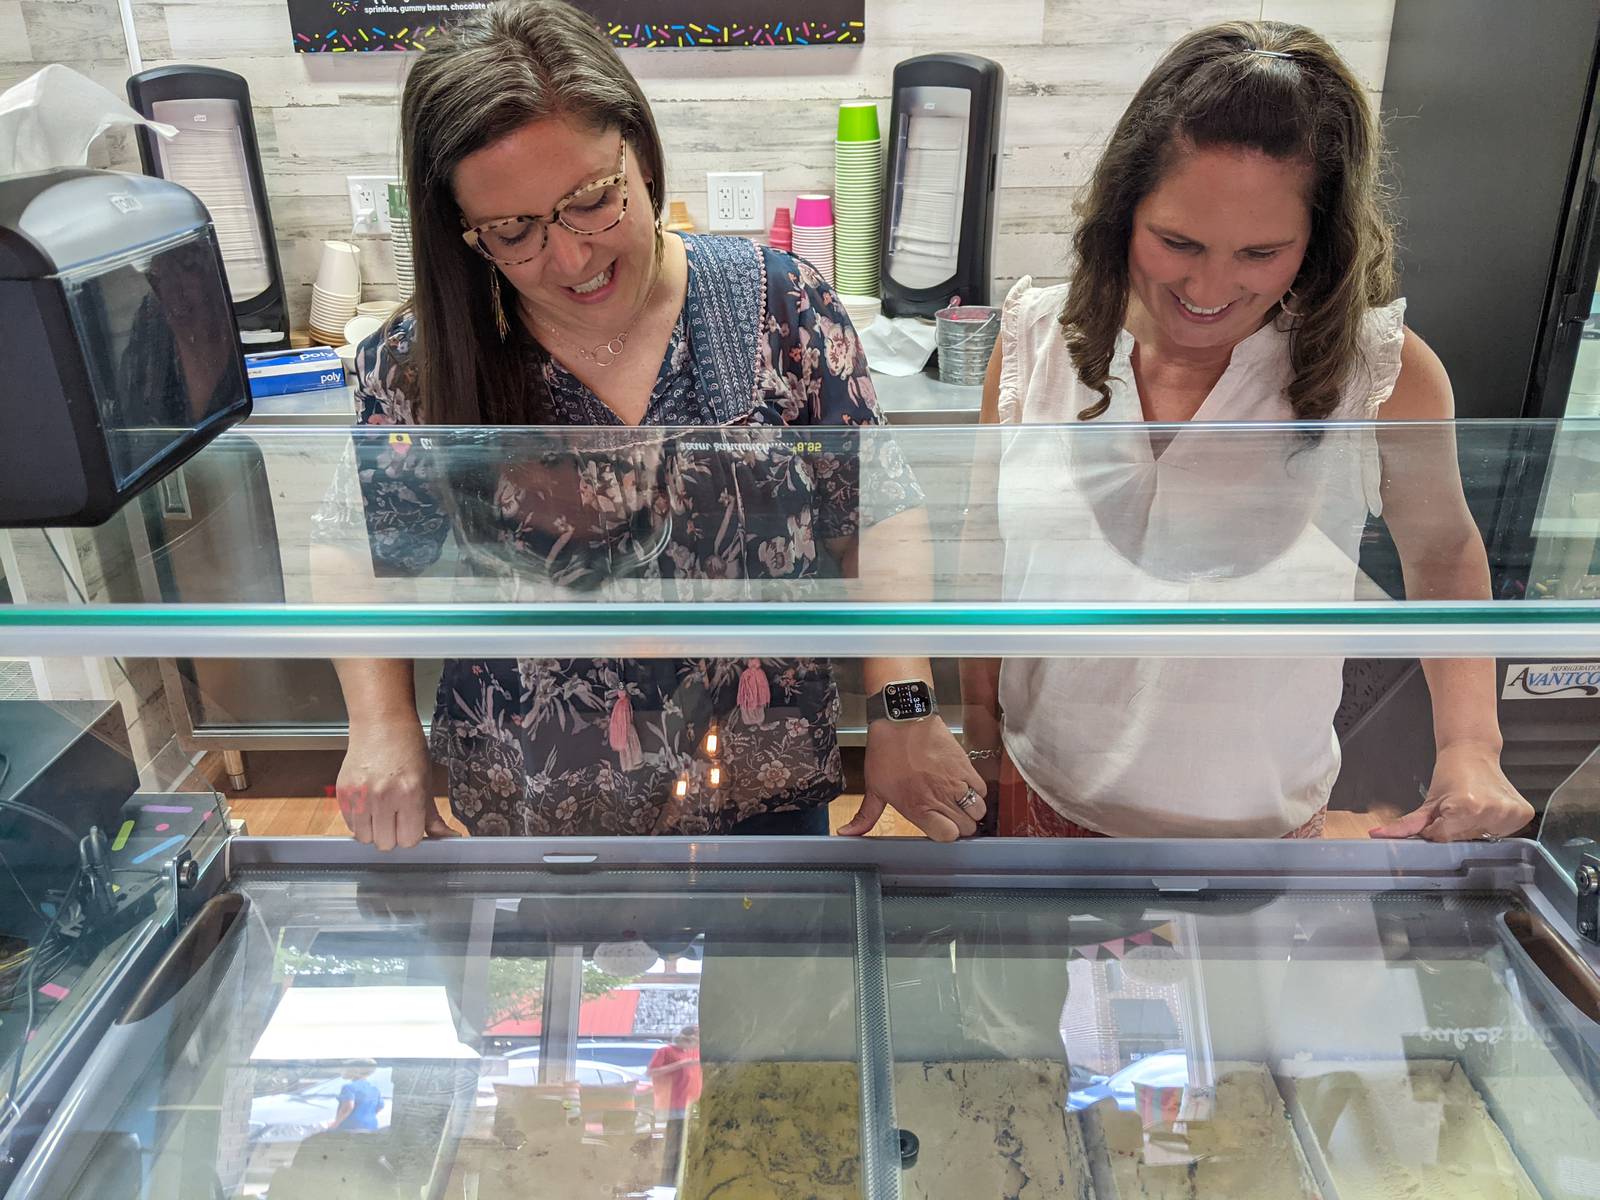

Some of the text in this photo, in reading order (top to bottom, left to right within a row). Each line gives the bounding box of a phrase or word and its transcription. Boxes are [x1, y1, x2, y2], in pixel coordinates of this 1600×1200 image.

[364, 6, 399, 15] sprinkles,
[400, 5, 426, 14] gummy
[427, 4, 450, 12] bears,
[450, 2, 486, 10] chocolate
[300, 352, 334, 361] poly
[321, 372, 341, 384] poly
[1506, 667, 1600, 690] AVANTCO
